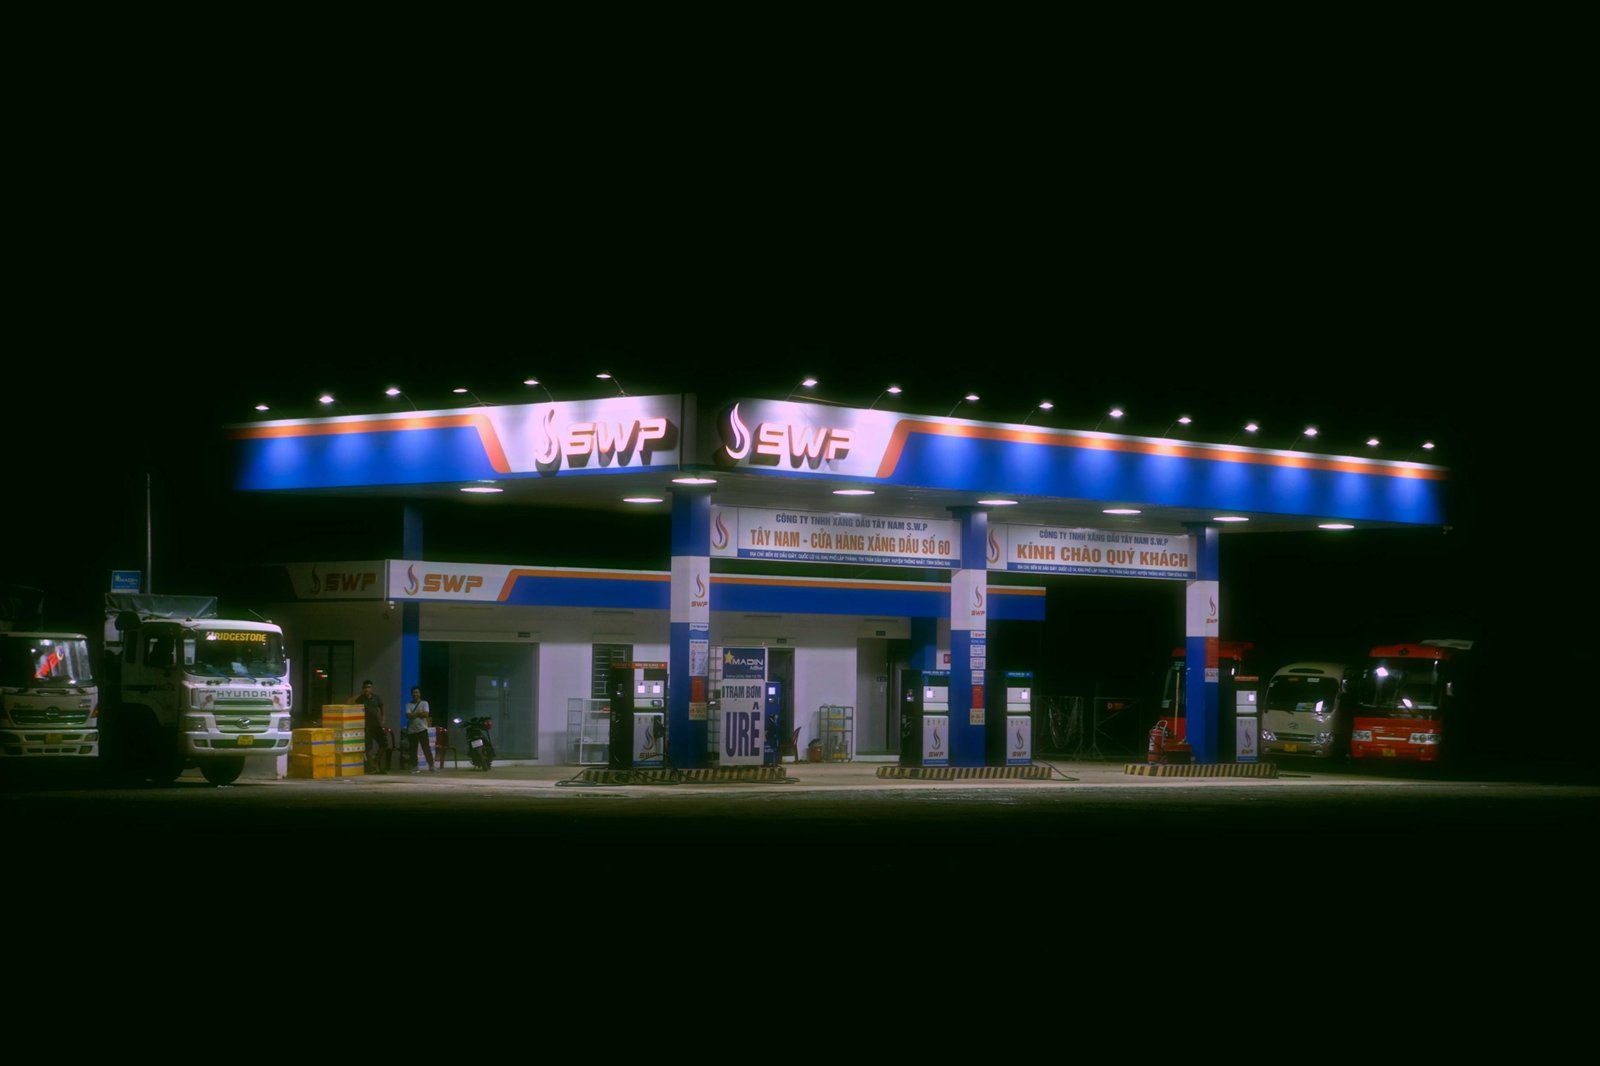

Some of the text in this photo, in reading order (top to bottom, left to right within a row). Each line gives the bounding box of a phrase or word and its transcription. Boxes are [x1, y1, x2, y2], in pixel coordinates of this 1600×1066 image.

[567, 418, 667, 456] SWP
[757, 422, 856, 460] SWP
[776, 513, 798, 524] CÔNG
[800, 516, 808, 524] TY
[810, 516, 830, 526] TNHH
[888, 521, 904, 530] NAM
[906, 522, 928, 532] S.W.P
[750, 526, 771, 546] TÂY
[774, 531, 800, 548] NAM
[810, 528, 832, 550] CỬA
[835, 531, 864, 551] HÀNG
[867, 534, 896, 553] XĂNG
[922, 534, 935, 555] SỐ
[938, 540, 950, 556] 60
[1040, 529, 1058, 539] CÔNG
[1059, 531, 1067, 540] TY
[1068, 533, 1086, 541] TNHH
[1134, 537, 1148, 545] NAM
[1150, 537, 1168, 546] S.W.P
[1017, 542, 1188, 568] KÍNH CHÀO QUÝ KHÁCH
[324, 573, 376, 592] SWP
[422, 574, 484, 593] SWP
[217, 690, 272, 698] HYUNDAI
[746, 685, 761, 698] BƠM
[725, 702, 760, 757] URÊ
